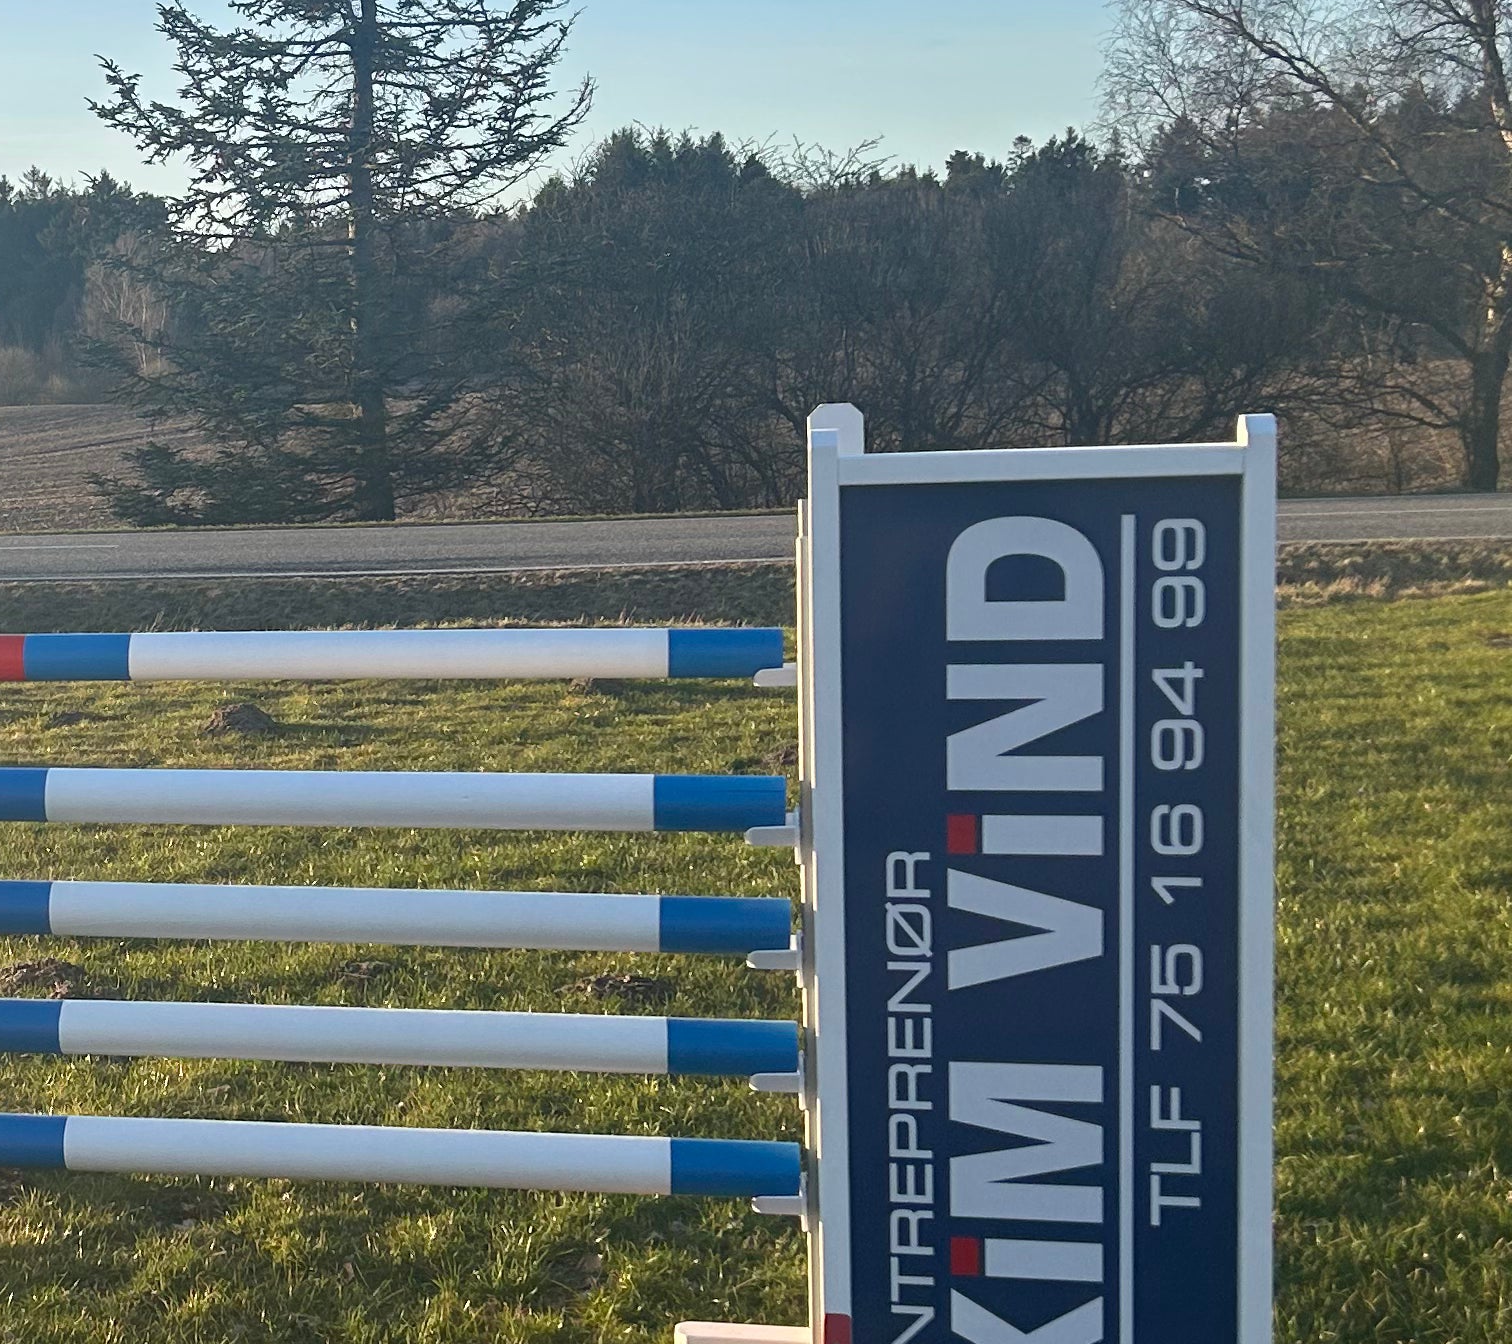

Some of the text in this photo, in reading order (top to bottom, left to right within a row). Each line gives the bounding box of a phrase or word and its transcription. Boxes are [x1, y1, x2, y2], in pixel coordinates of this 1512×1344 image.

[1150, 517, 1206, 1226] TLF 75 16 94 99
